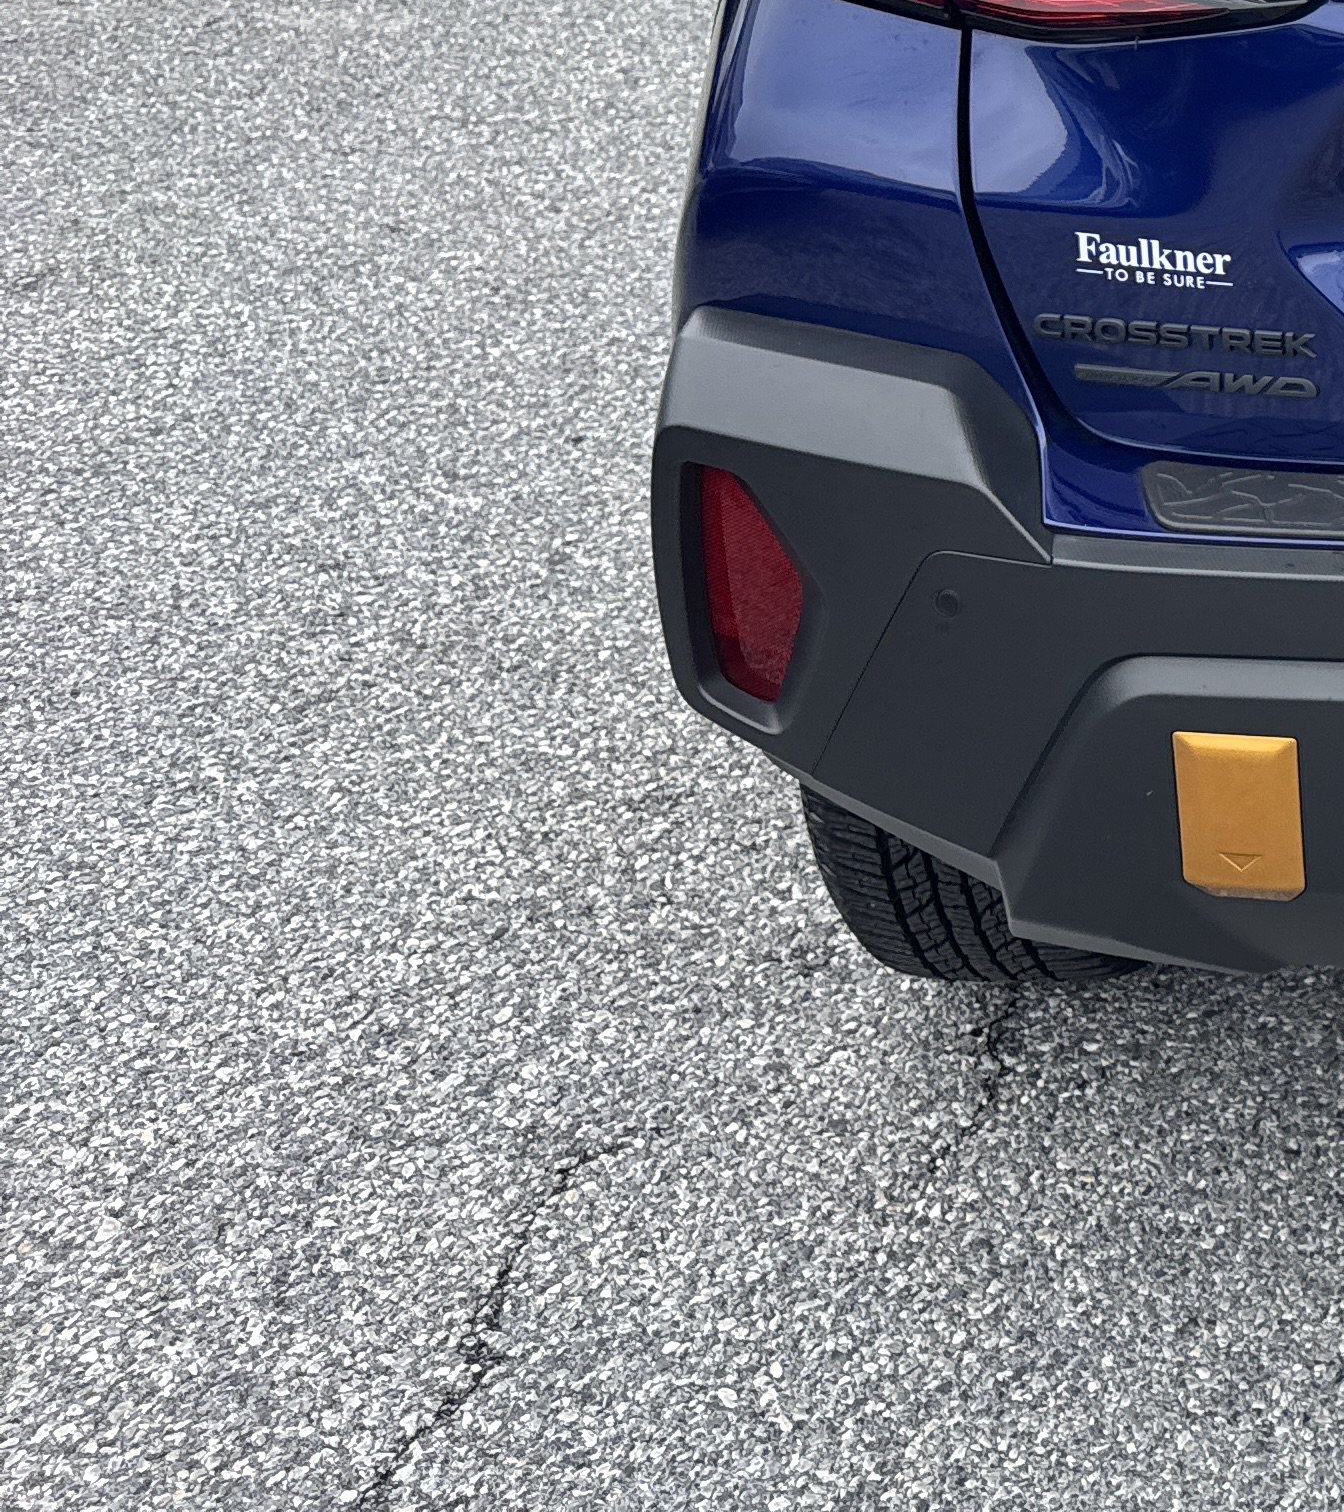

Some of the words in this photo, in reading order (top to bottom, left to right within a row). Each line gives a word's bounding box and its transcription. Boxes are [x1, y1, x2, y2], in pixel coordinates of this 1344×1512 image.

[1074, 231, 1232, 275] Faulkner
[1104, 267, 1129, 282] TO
[1135, 271, 1156, 285] BE
[1163, 274, 1206, 289] SURE
[1034, 314, 1317, 358] CROSSTREK
[1163, 371, 1320, 398] AWD
